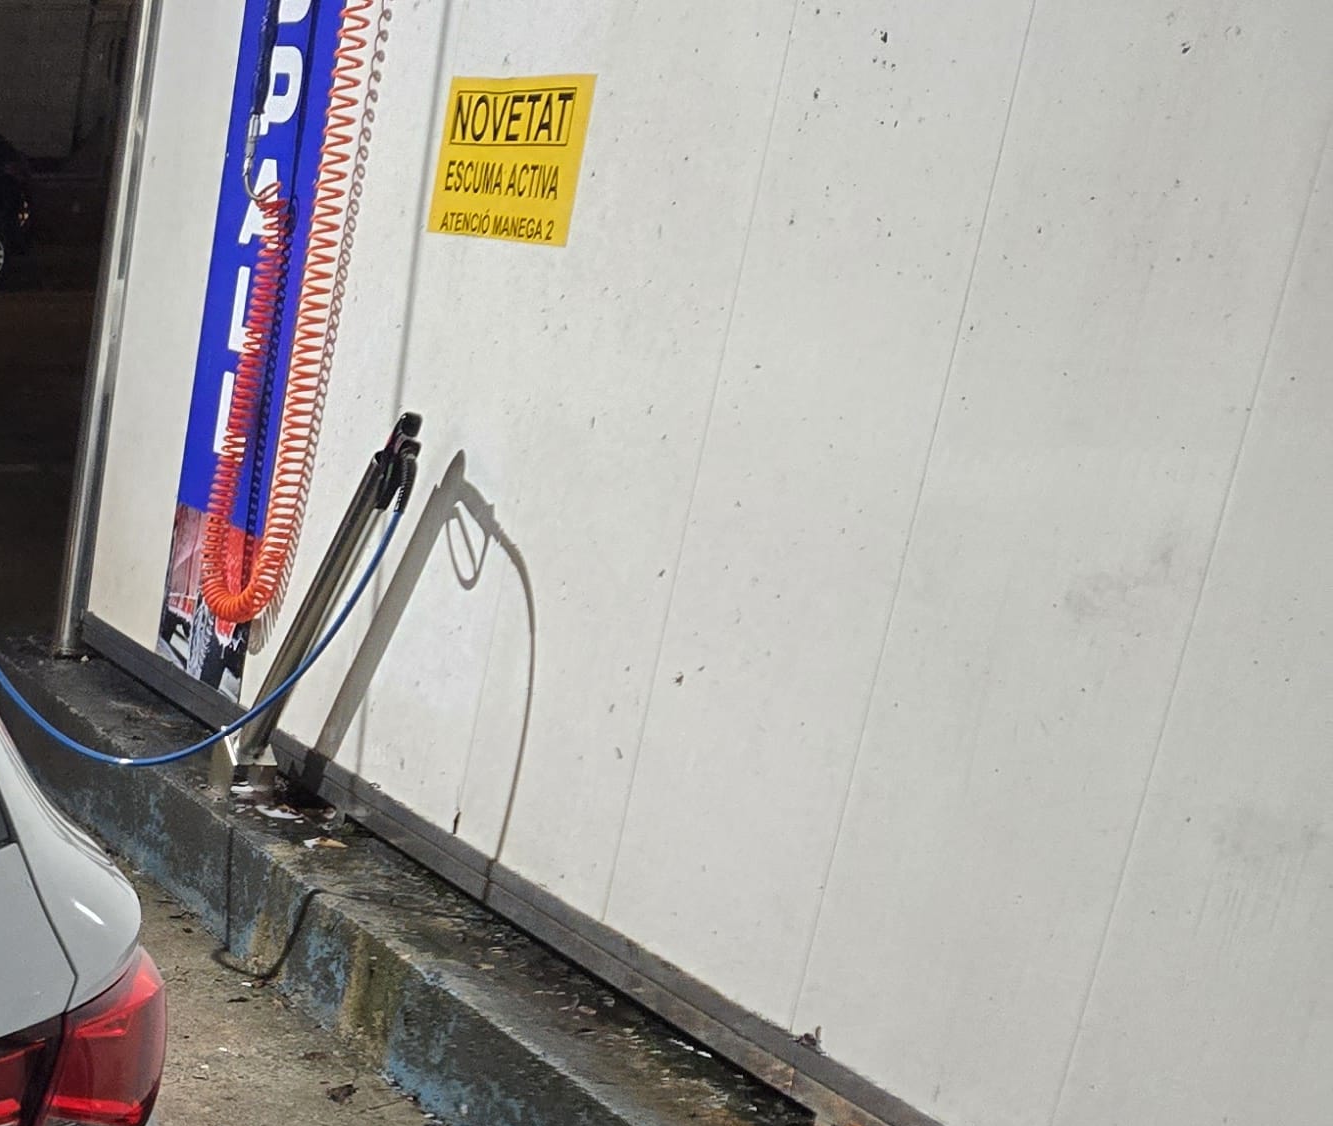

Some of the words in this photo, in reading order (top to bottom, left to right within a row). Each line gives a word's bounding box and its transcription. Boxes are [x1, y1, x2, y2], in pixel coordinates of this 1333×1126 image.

[450, 92, 575, 142] NOVETAT
[444, 159, 504, 196] ESCUMA
[504, 162, 560, 201] ACTIVA
[439, 208, 491, 234] ATENCIÓ
[491, 214, 543, 240] MANEGA
[544, 219, 555, 241] 2
